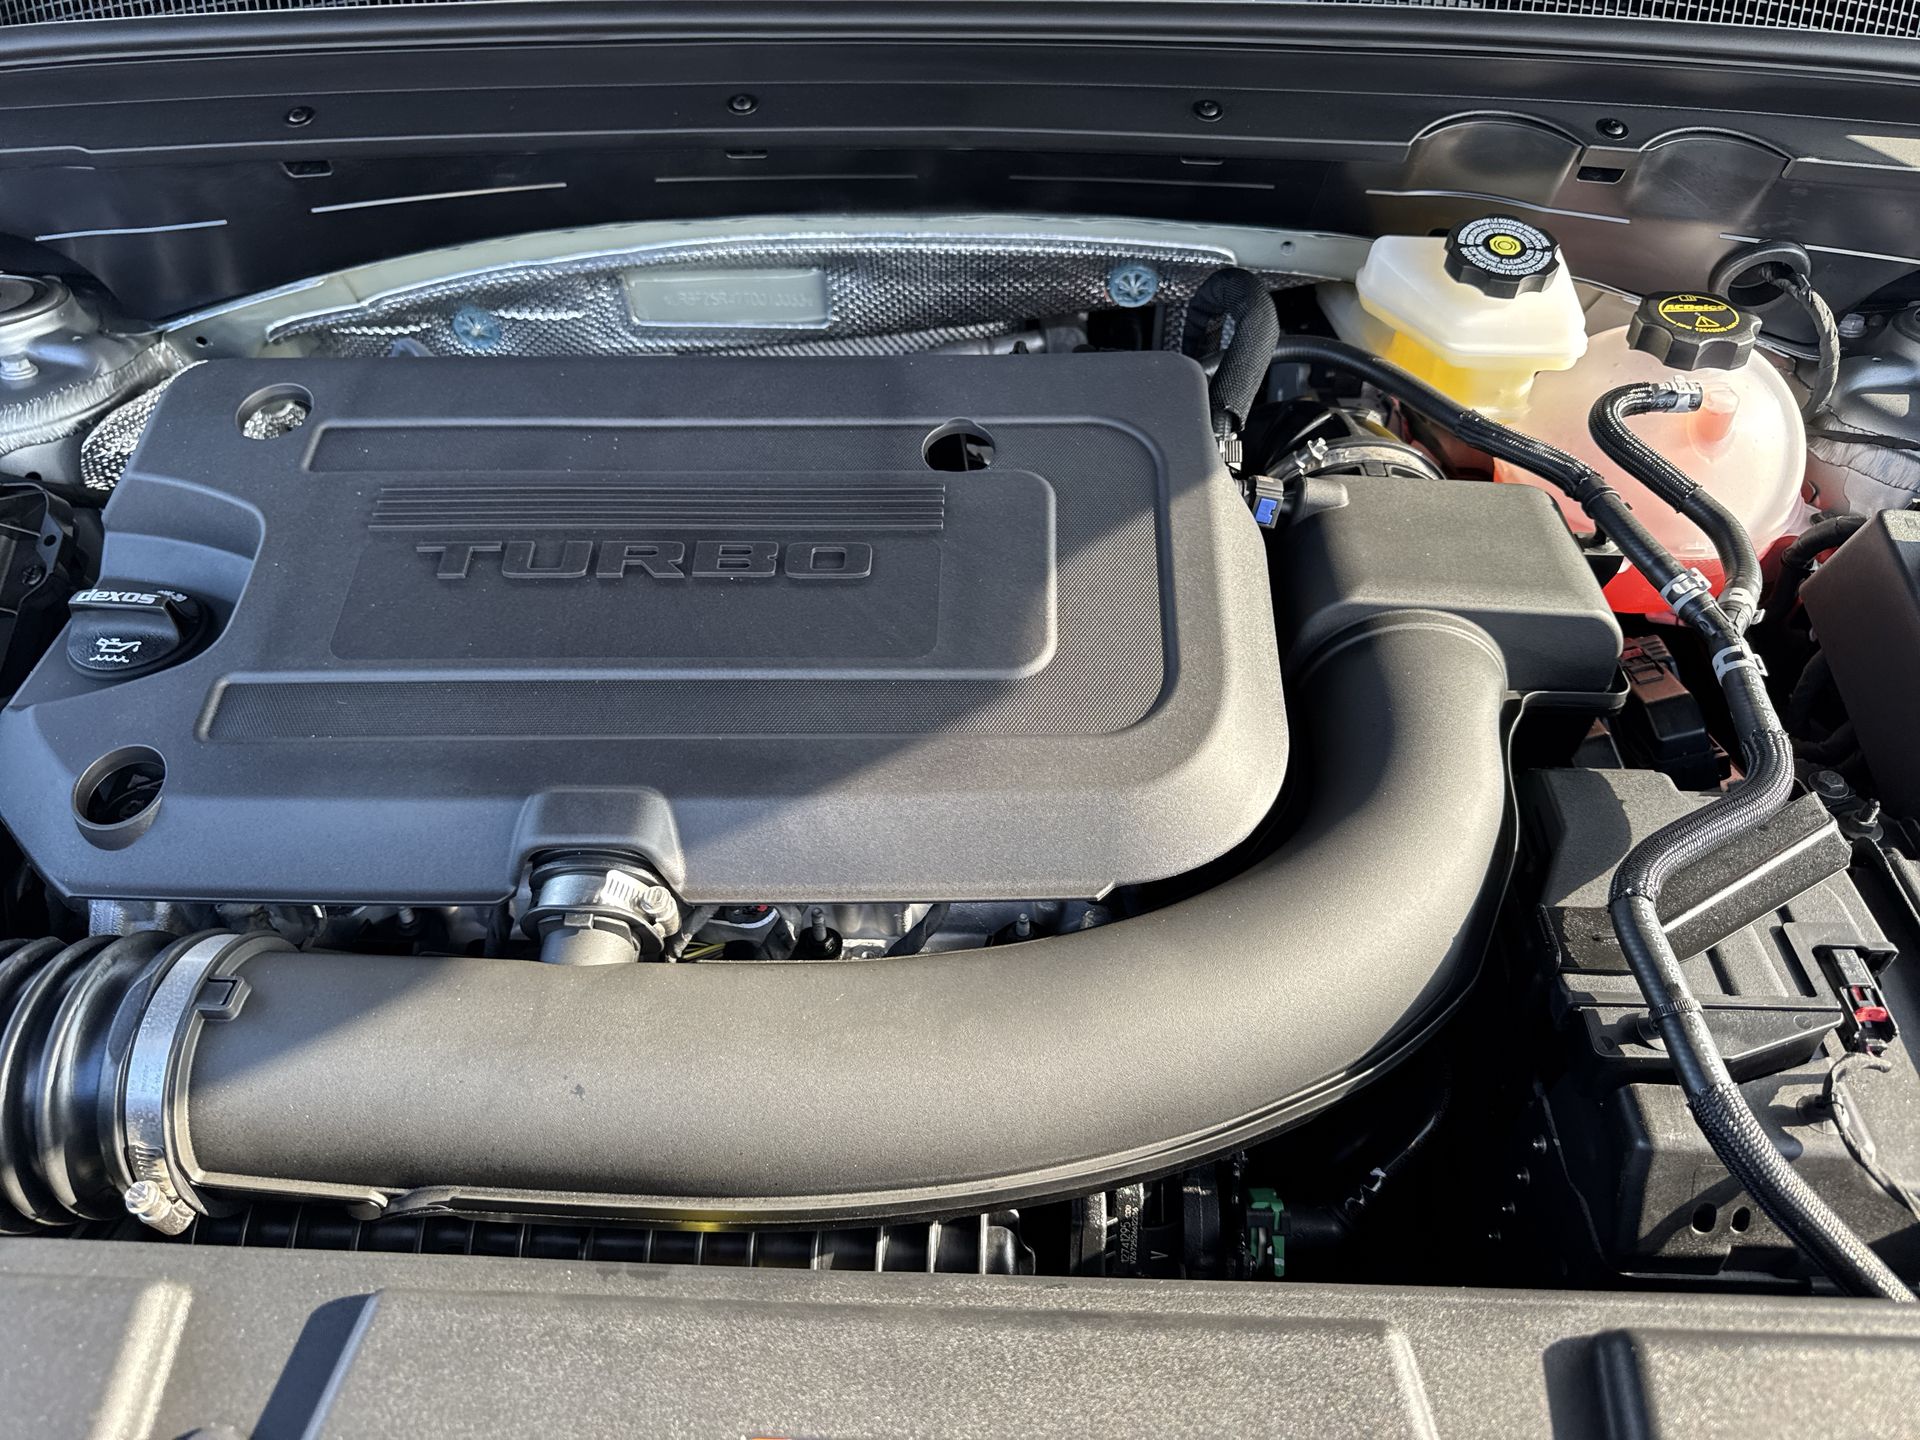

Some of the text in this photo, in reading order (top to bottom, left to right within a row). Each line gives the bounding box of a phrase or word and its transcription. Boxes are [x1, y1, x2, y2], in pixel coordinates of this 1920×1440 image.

[1485, 265, 1505, 274] FROM
[1662, 304, 1728, 312] ACDelco
[416, 540, 873, 579] TURBO
[76, 589, 161, 604] dexos
[1120, 1221, 1131, 1263] 12741295
